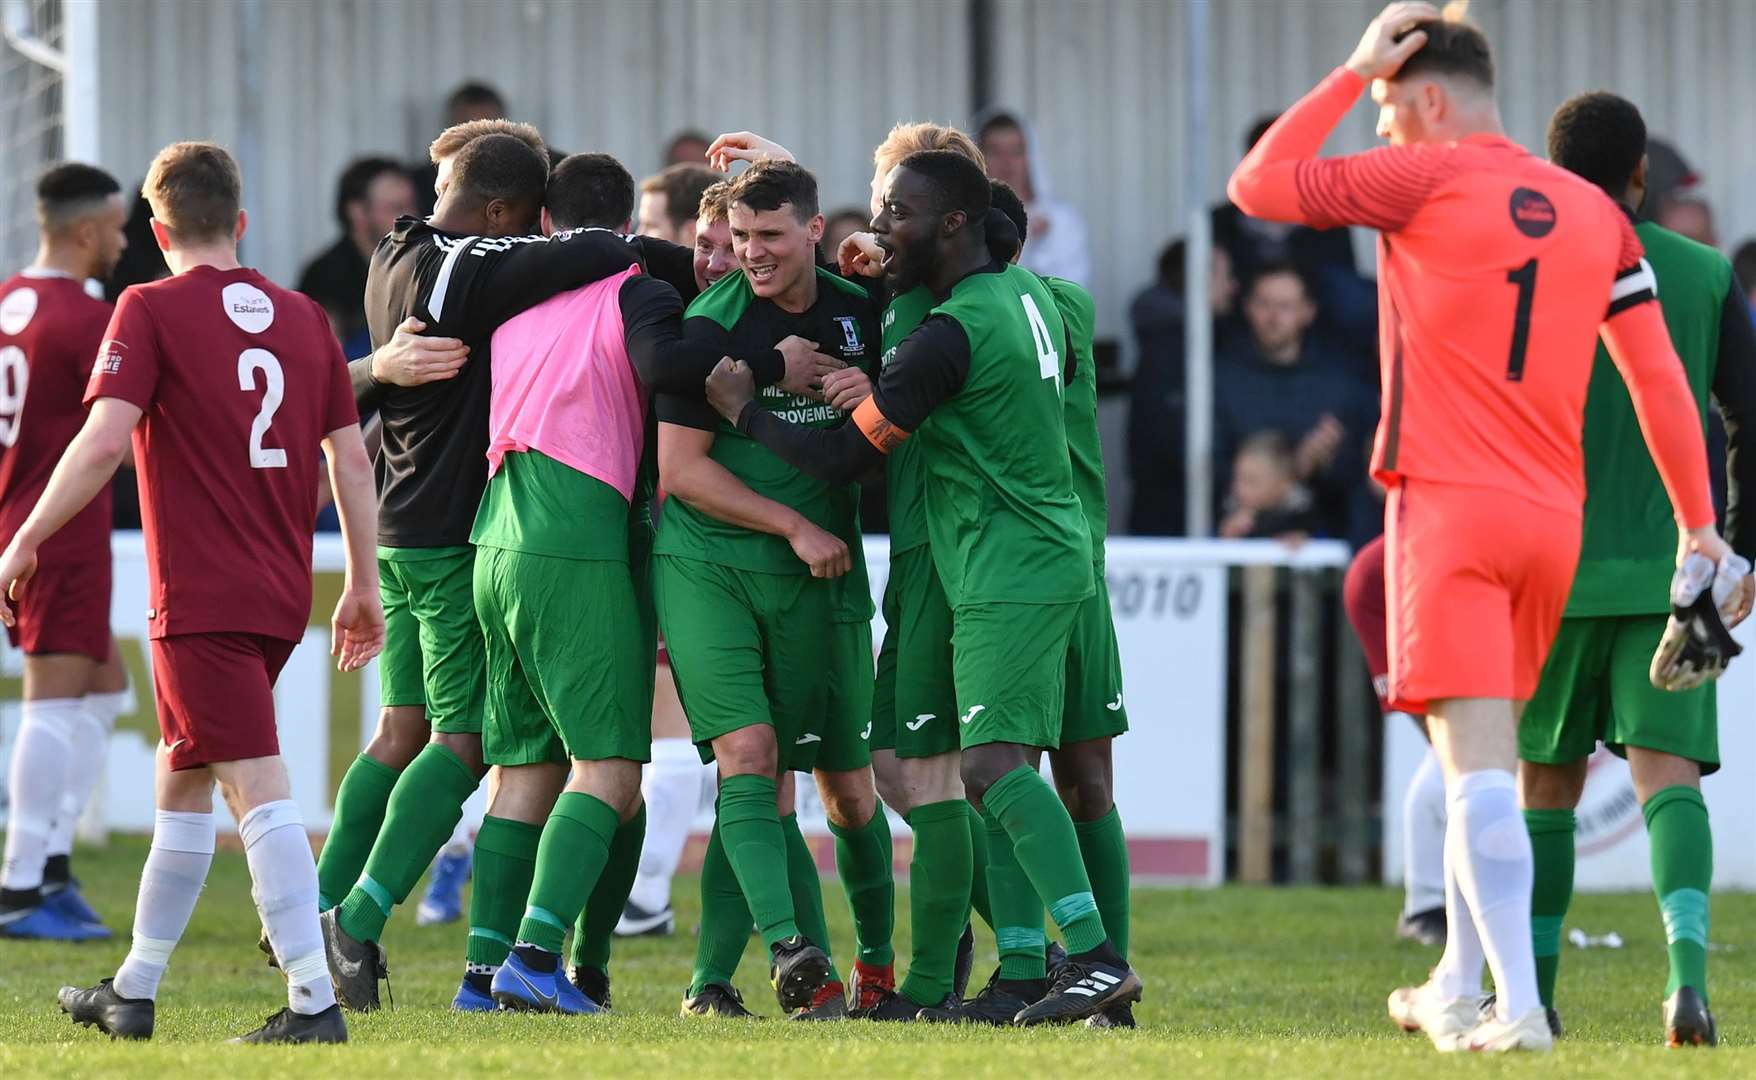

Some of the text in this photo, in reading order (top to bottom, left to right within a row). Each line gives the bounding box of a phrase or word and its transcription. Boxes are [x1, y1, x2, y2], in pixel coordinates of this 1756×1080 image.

[1020, 293, 1061, 401] 4
[1506, 257, 1539, 382] 1
[0, 345, 30, 448] 9
[237, 347, 289, 469] 2
